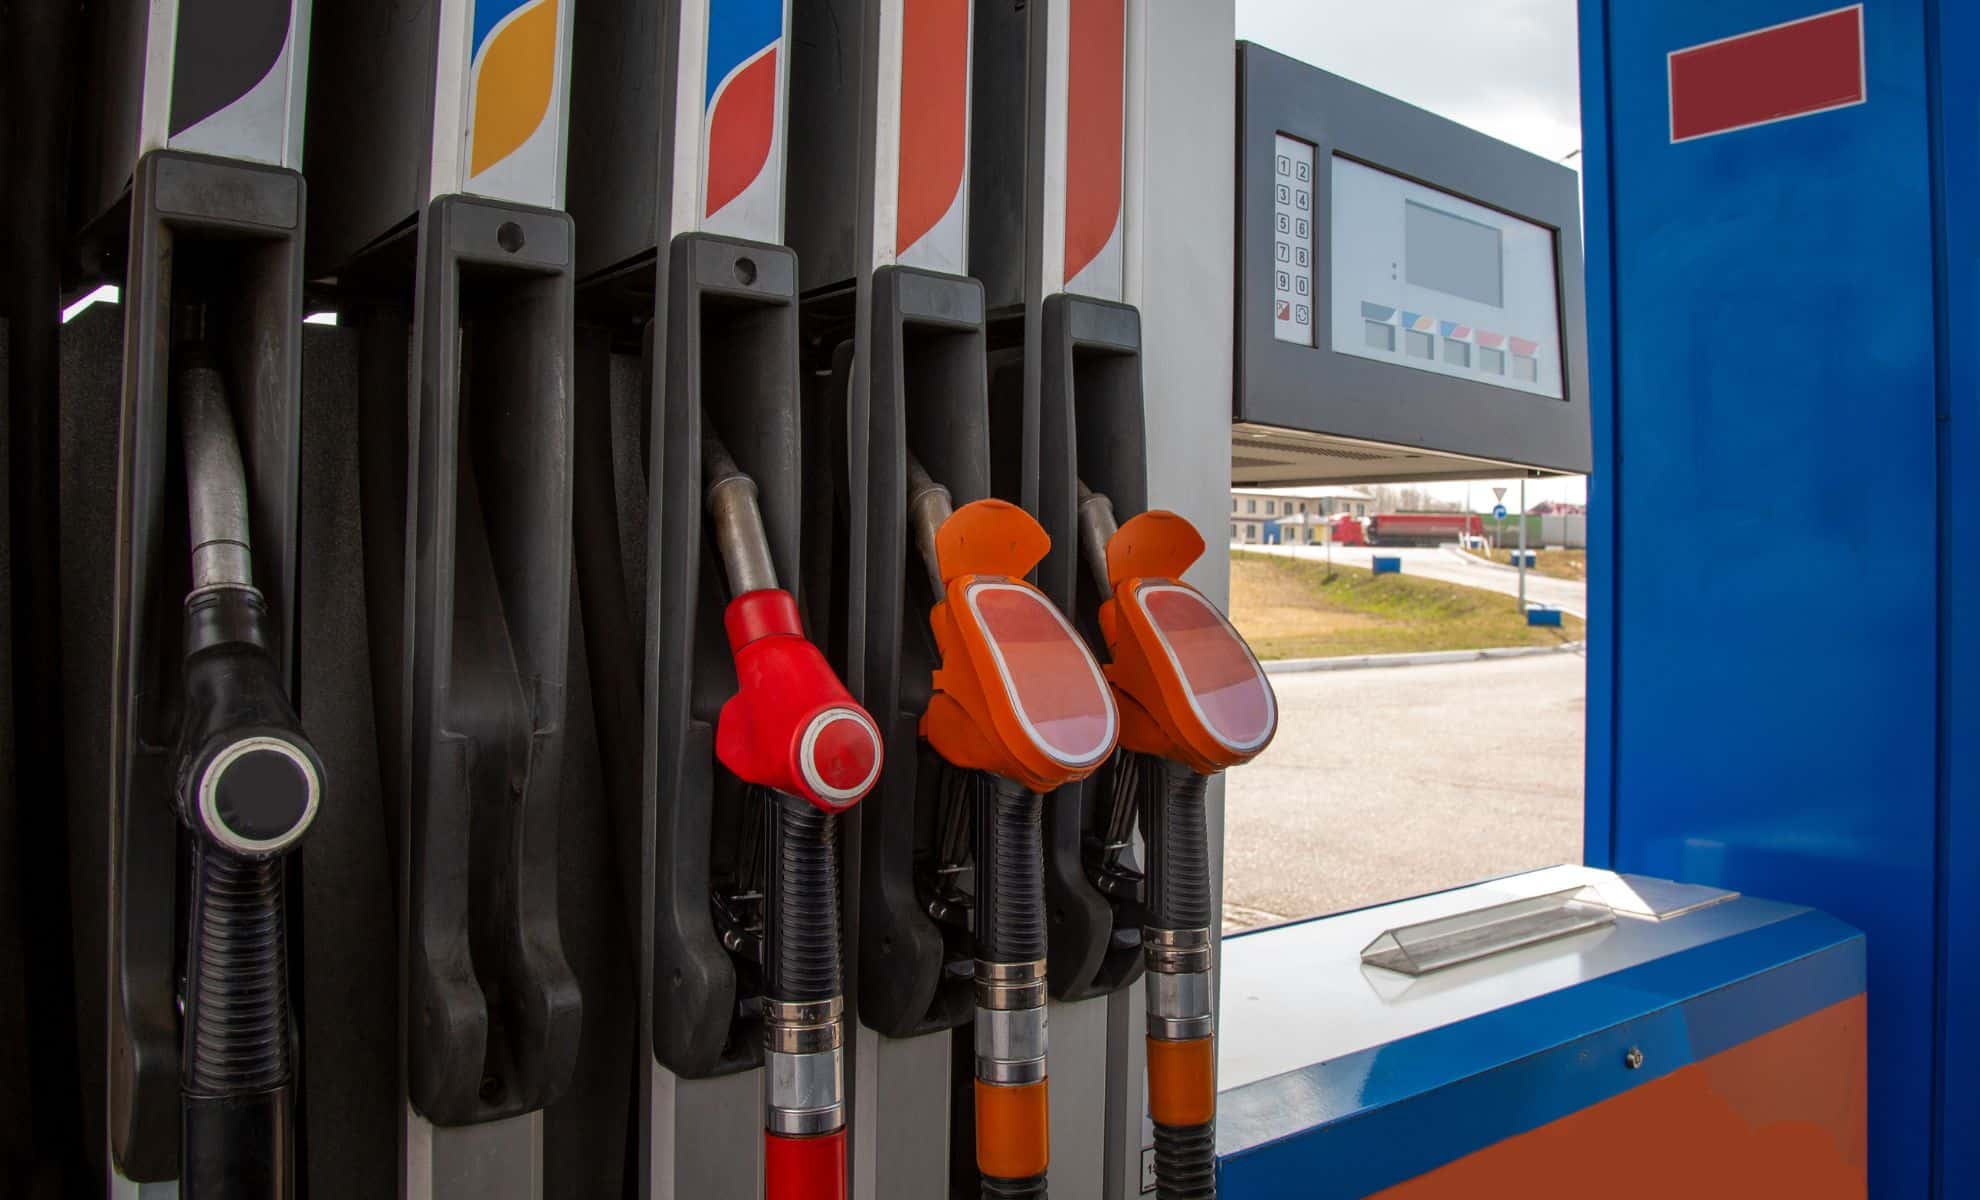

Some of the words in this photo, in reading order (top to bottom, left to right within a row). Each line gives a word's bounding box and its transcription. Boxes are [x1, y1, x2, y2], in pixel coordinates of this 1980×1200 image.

[1281, 160, 1286, 172] 1
[1299, 166, 1306, 179] 2
[1280, 188, 1287, 201] 3
[1299, 194, 1305, 206] 4
[1280, 217, 1286, 229] 5
[1299, 222, 1305, 235] 6
[1280, 246, 1286, 258] 7
[1299, 251, 1305, 263] 8
[1280, 275, 1286, 287] 9
[1299, 280, 1305, 292] 0
